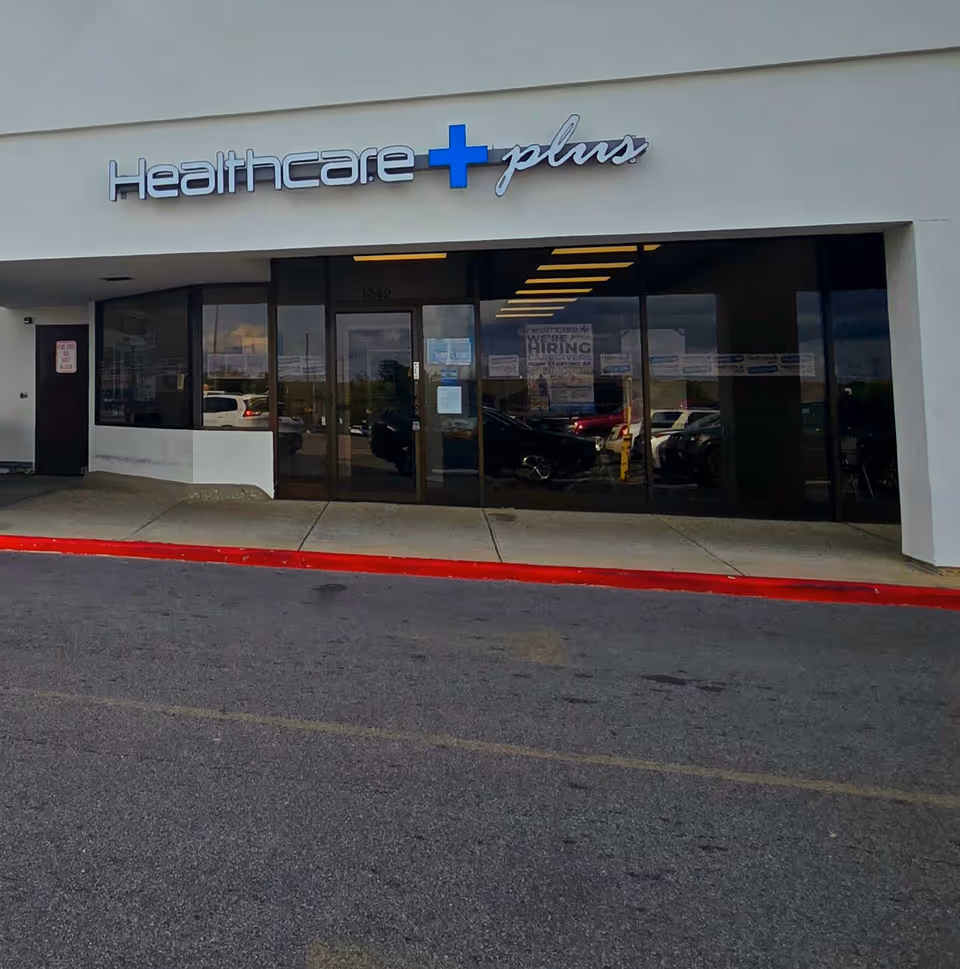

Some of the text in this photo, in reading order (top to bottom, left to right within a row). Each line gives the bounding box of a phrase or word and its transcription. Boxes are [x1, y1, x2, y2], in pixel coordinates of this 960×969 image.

[108, 114, 649, 201] Healthcare plus
[528, 342, 591, 354] HIRING
